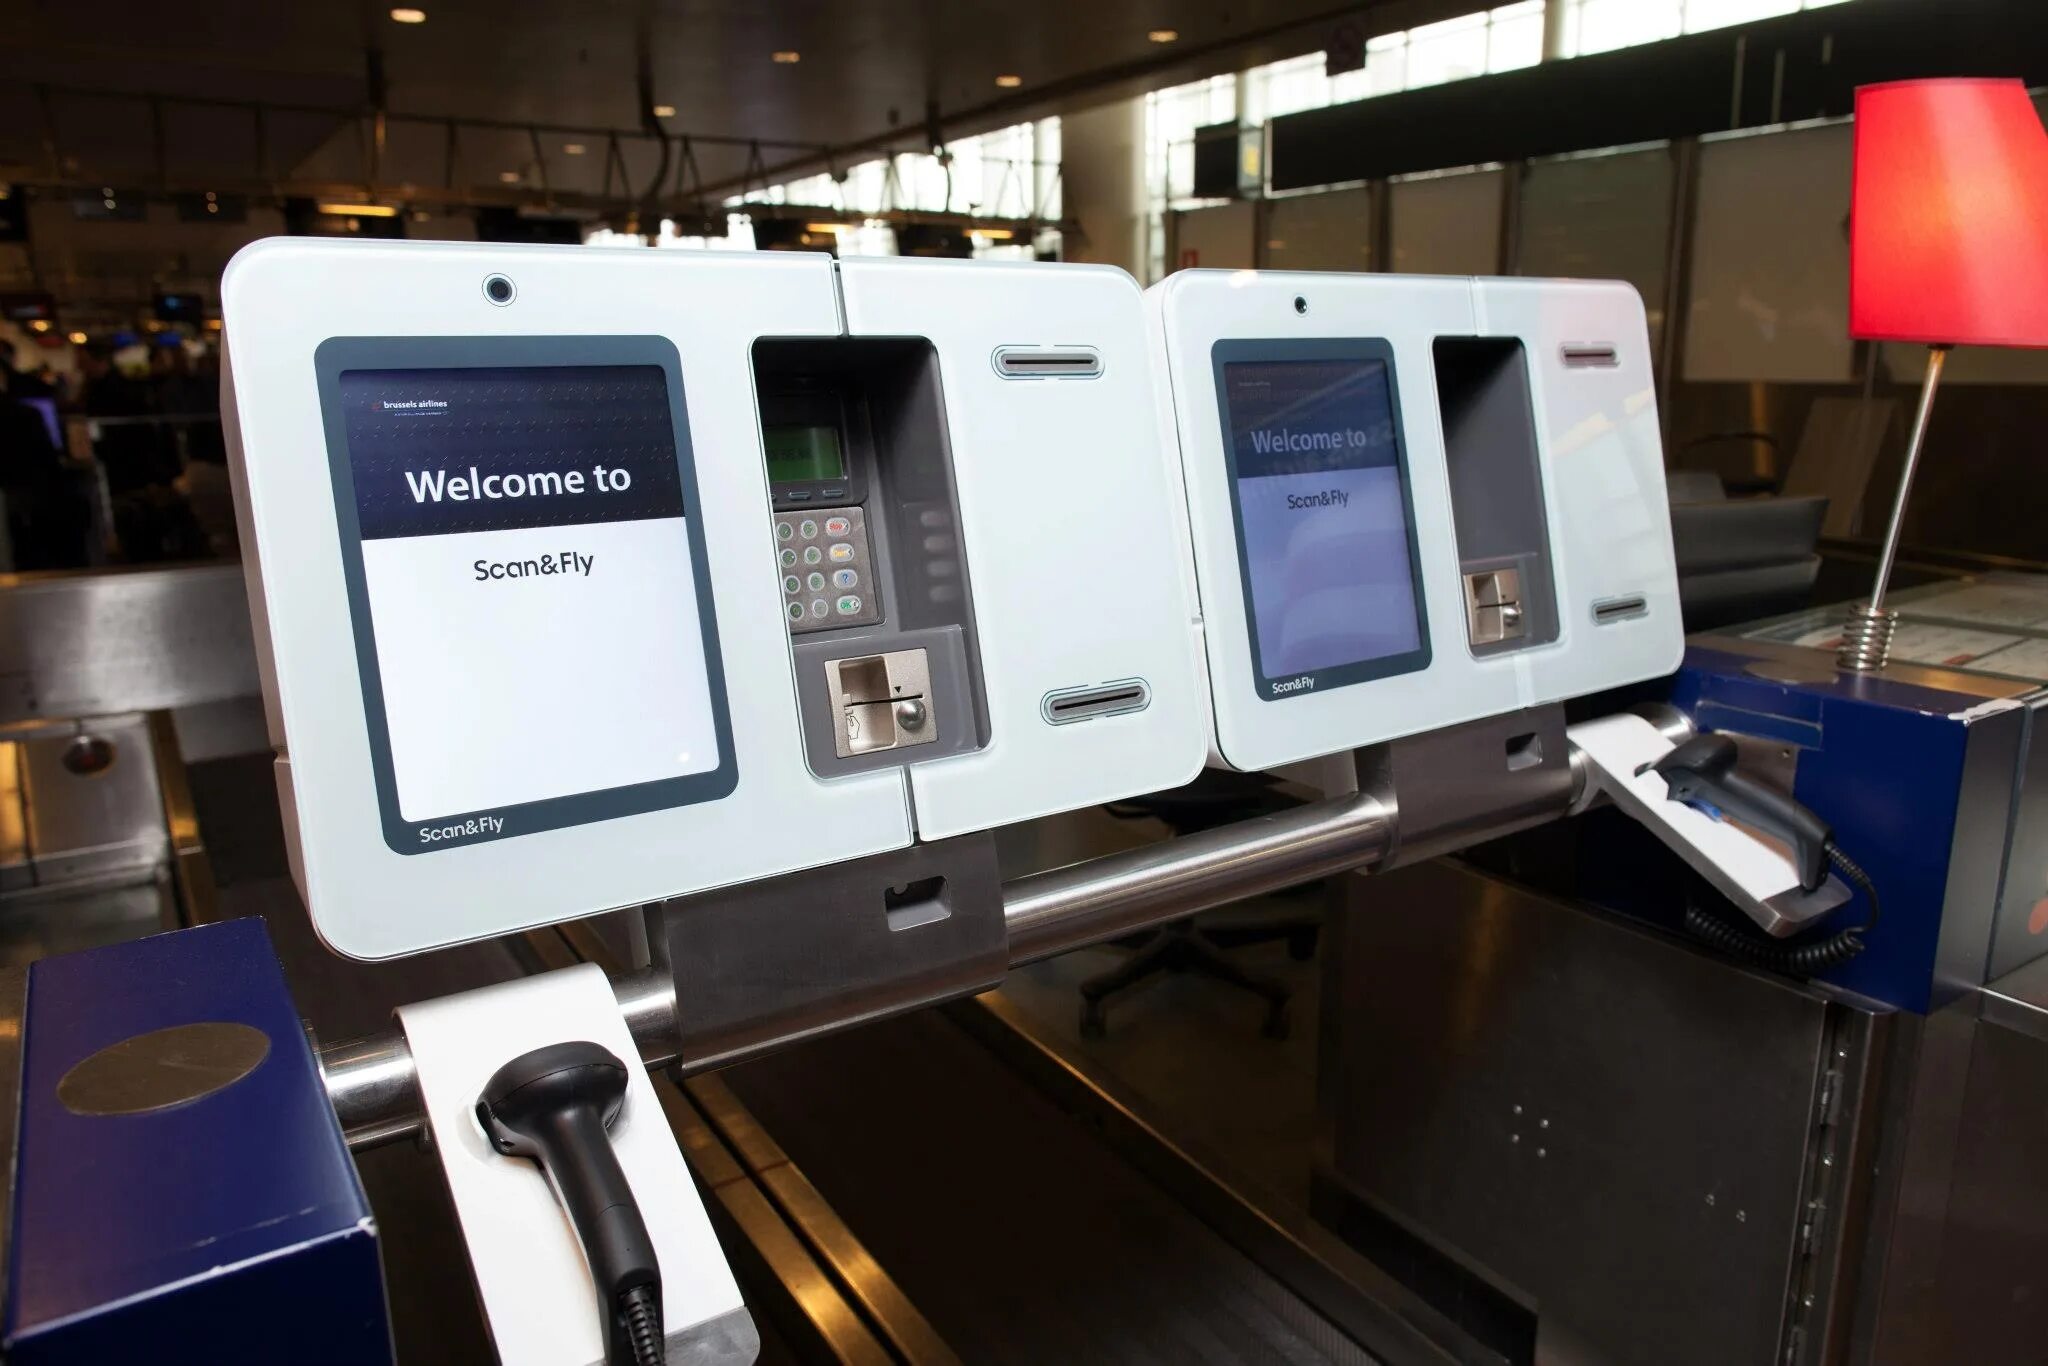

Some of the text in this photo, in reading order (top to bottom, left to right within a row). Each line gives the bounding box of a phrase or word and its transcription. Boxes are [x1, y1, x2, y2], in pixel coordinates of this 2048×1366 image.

[383, 400, 448, 409] brussels airlines
[1250, 428, 1367, 453] Welcome to
[405, 465, 632, 503] Welcome to
[1287, 489, 1349, 510] Scan&Fly
[474, 551, 594, 581] Scan&Fly
[1272, 676, 1315, 694] Scan&Fly
[420, 816, 504, 843] Scan&Fly
